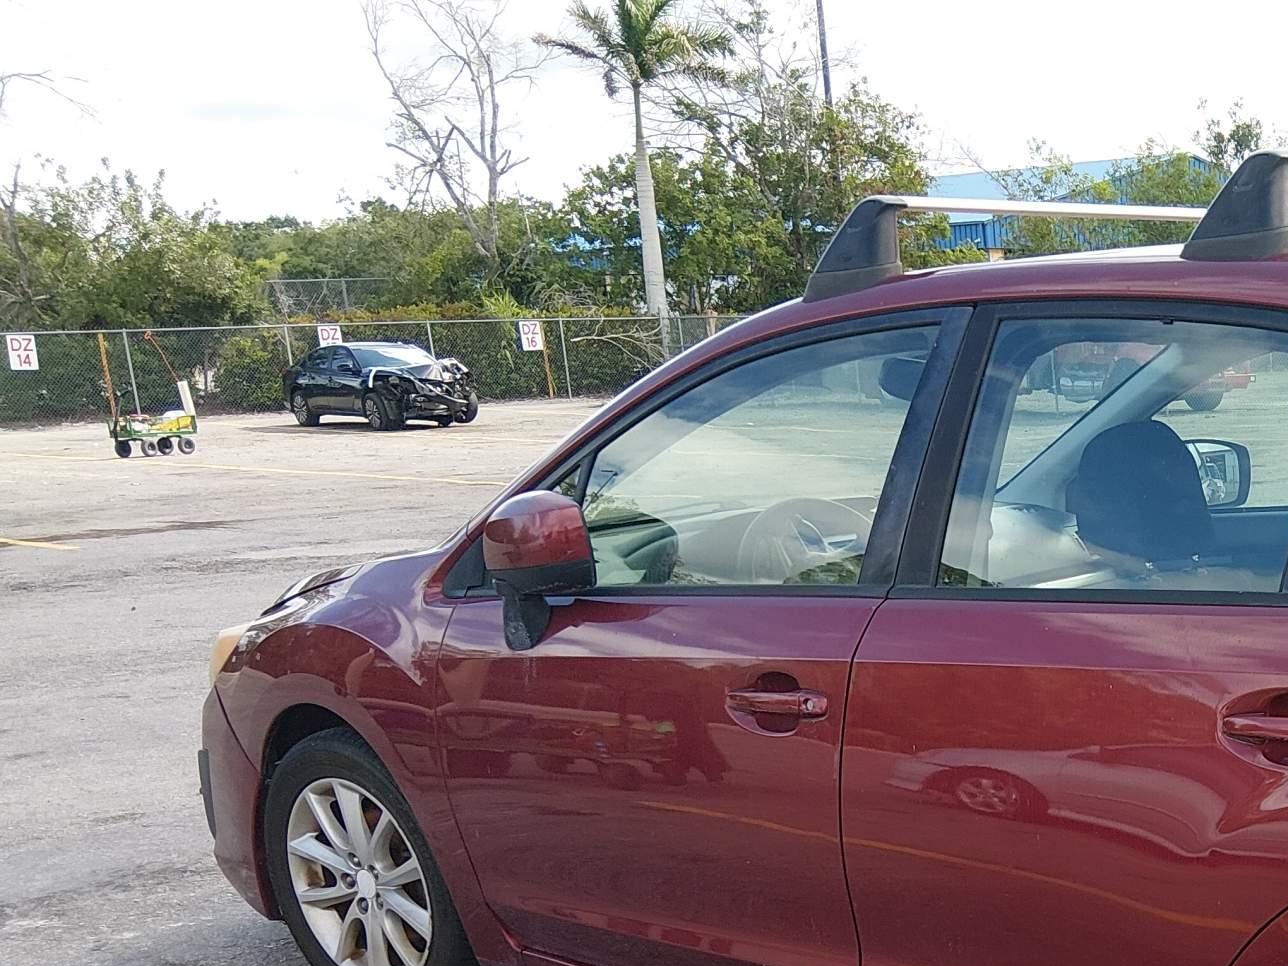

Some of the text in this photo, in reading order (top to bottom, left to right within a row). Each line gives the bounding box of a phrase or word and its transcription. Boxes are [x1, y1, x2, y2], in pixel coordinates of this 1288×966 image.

[320, 328, 340, 341] DZ
[521, 323, 539, 335] DZ
[10, 337, 33, 352] DZ
[526, 336, 538, 348] 16
[17, 353, 32, 367] 14
